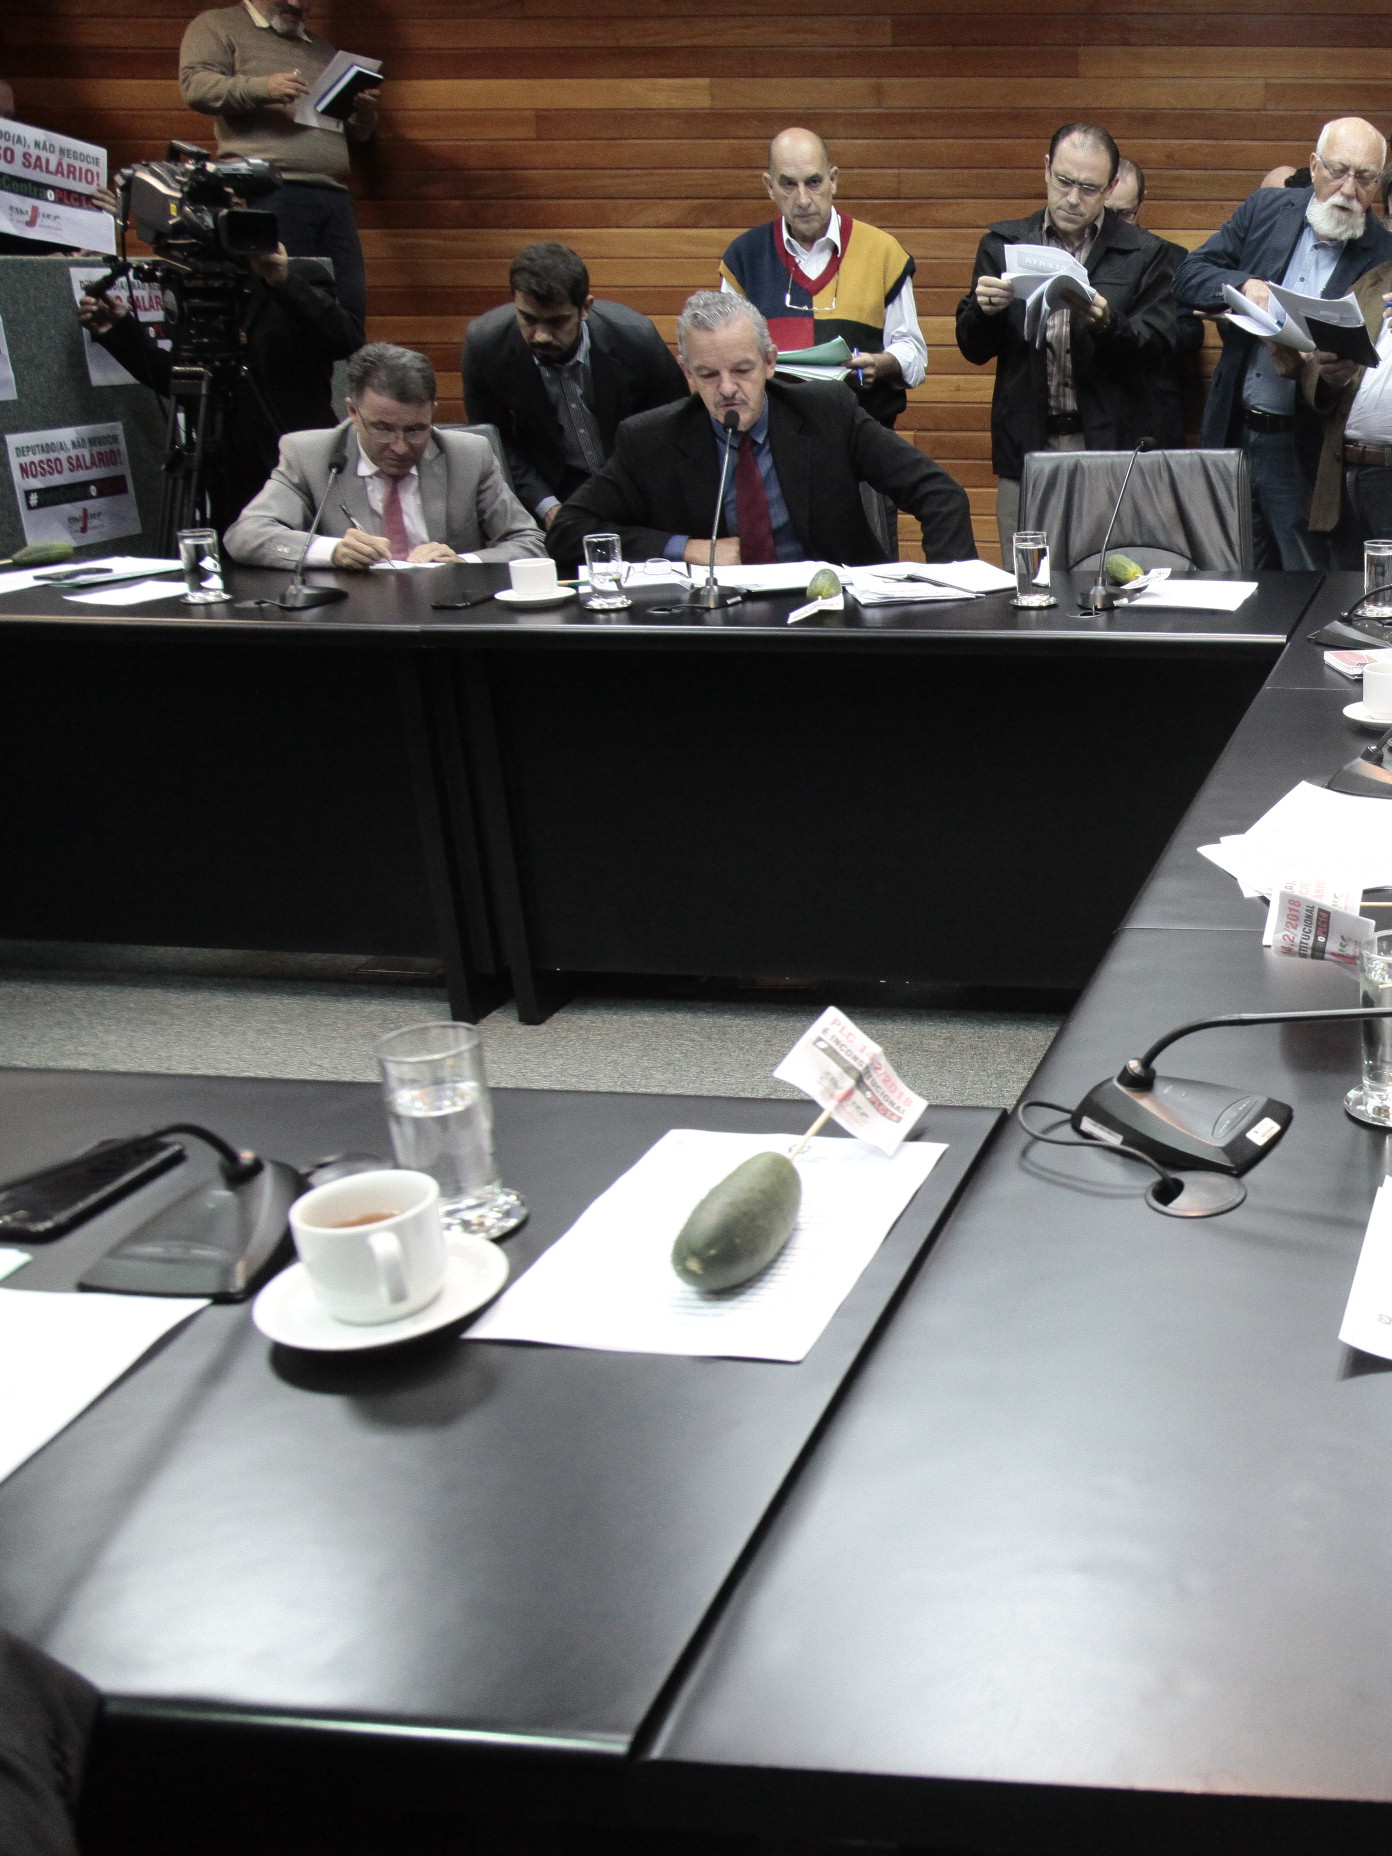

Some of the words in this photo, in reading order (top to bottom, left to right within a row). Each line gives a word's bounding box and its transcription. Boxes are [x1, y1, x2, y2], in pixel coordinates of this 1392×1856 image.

[0, 145, 16, 164] O
[59, 146, 100, 167] NEGOCIE
[18, 457, 64, 480] NOSSO
[829, 1017, 857, 1044] PLC
